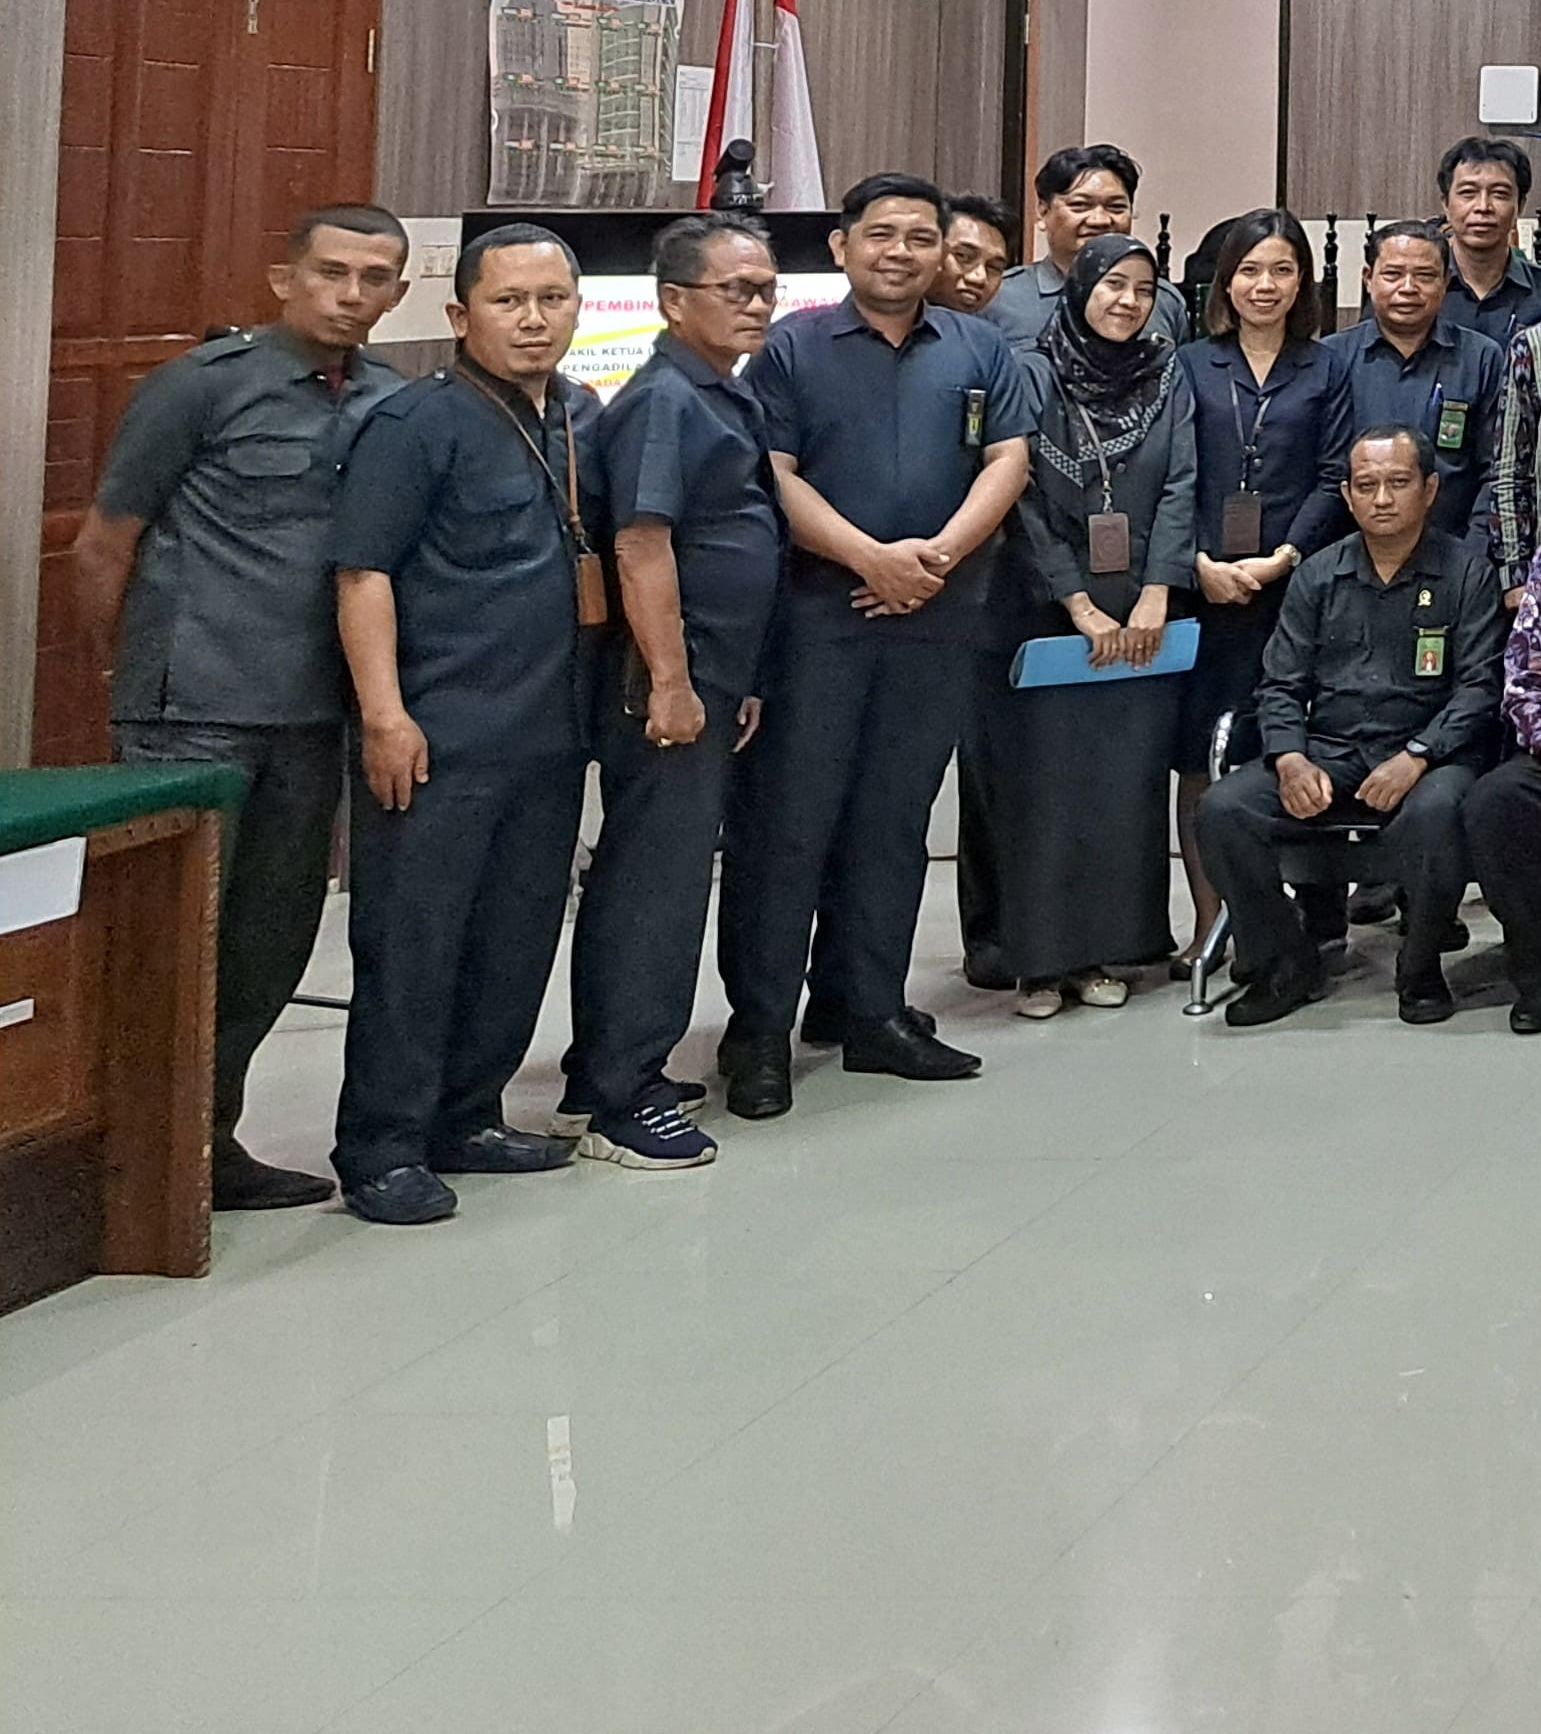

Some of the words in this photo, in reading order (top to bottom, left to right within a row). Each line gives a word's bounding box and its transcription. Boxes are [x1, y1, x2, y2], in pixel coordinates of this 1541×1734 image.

[584, 299, 656, 312] PEMBIN
[569, 347, 598, 356] AKIL
[601, 346, 644, 356] KETUA
[563, 362, 641, 373] PENGADIL
